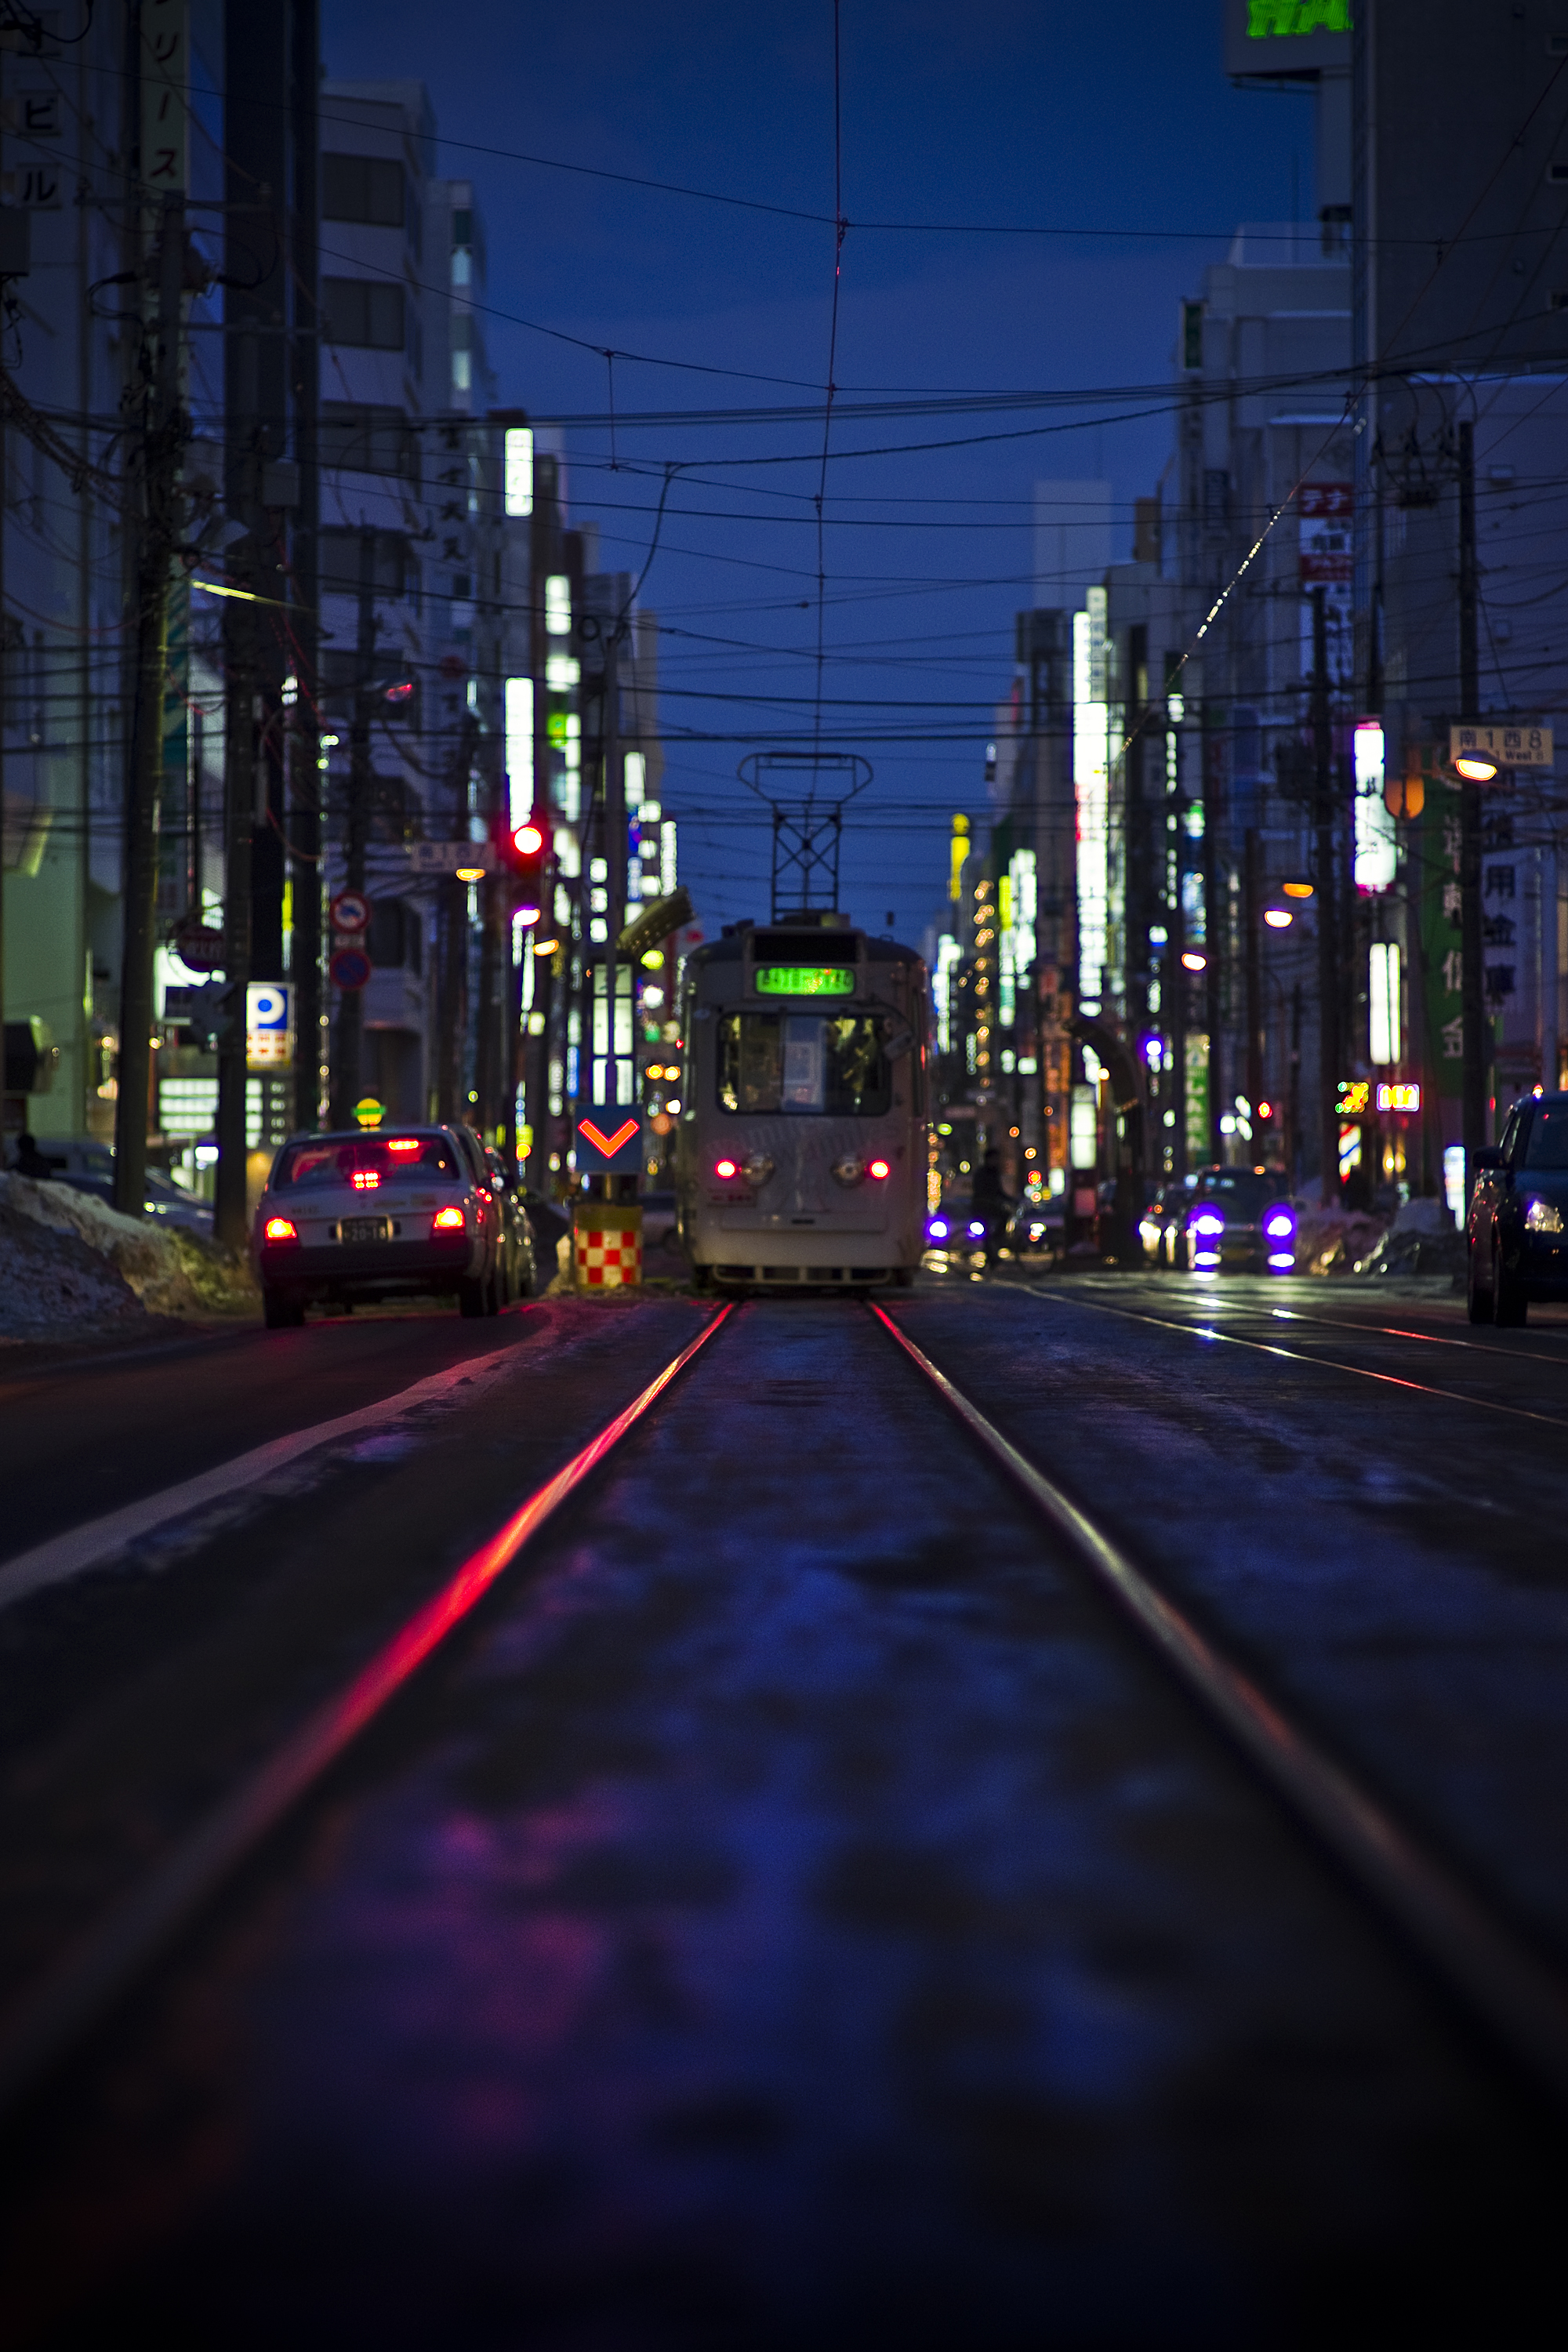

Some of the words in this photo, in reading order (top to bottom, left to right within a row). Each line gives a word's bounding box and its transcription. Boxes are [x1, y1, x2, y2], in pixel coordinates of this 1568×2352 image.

[150, 0, 180, 177] リース
[24, 97, 56, 202] ビル
[246, 987, 285, 1029] P
